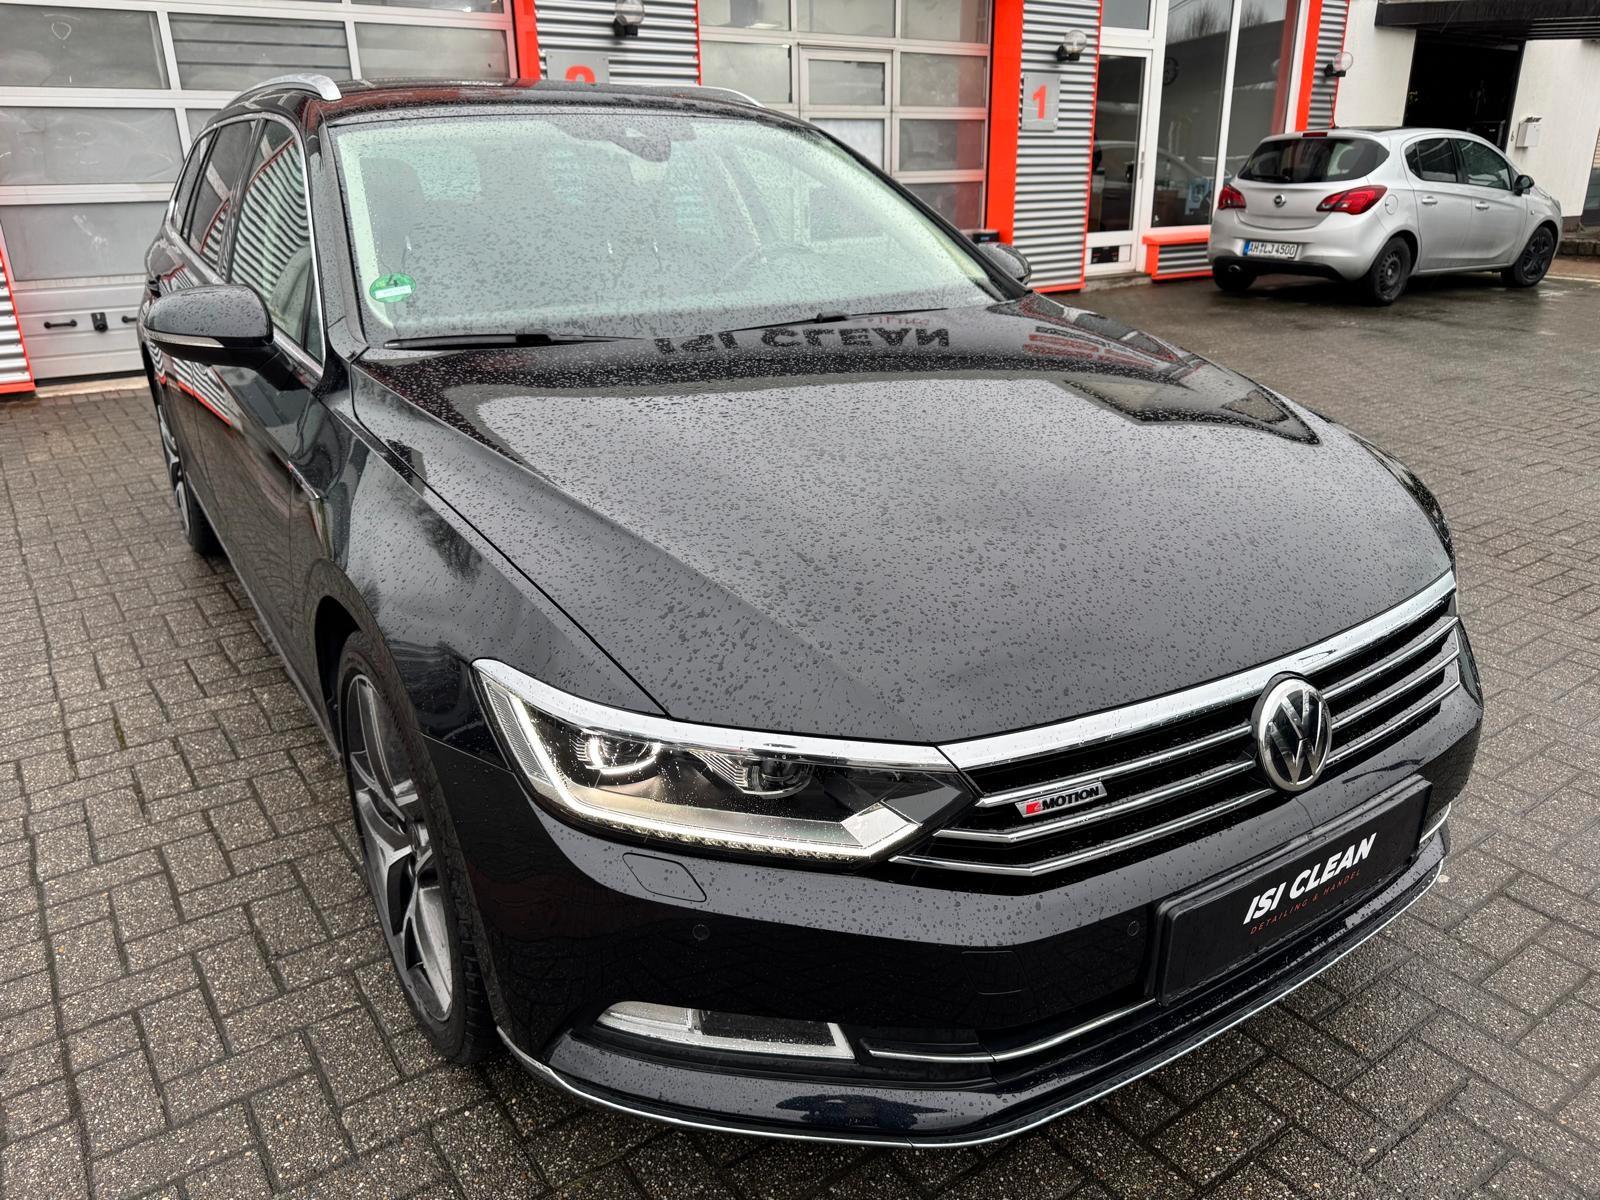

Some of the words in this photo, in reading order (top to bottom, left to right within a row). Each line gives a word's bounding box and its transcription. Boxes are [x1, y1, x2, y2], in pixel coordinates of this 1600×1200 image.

[1032, 85, 1047, 120] 1
[1243, 881, 1287, 925] ISI
[1289, 832, 1377, 899] CLEAN
[1250, 898, 1308, 935] DETAILING
